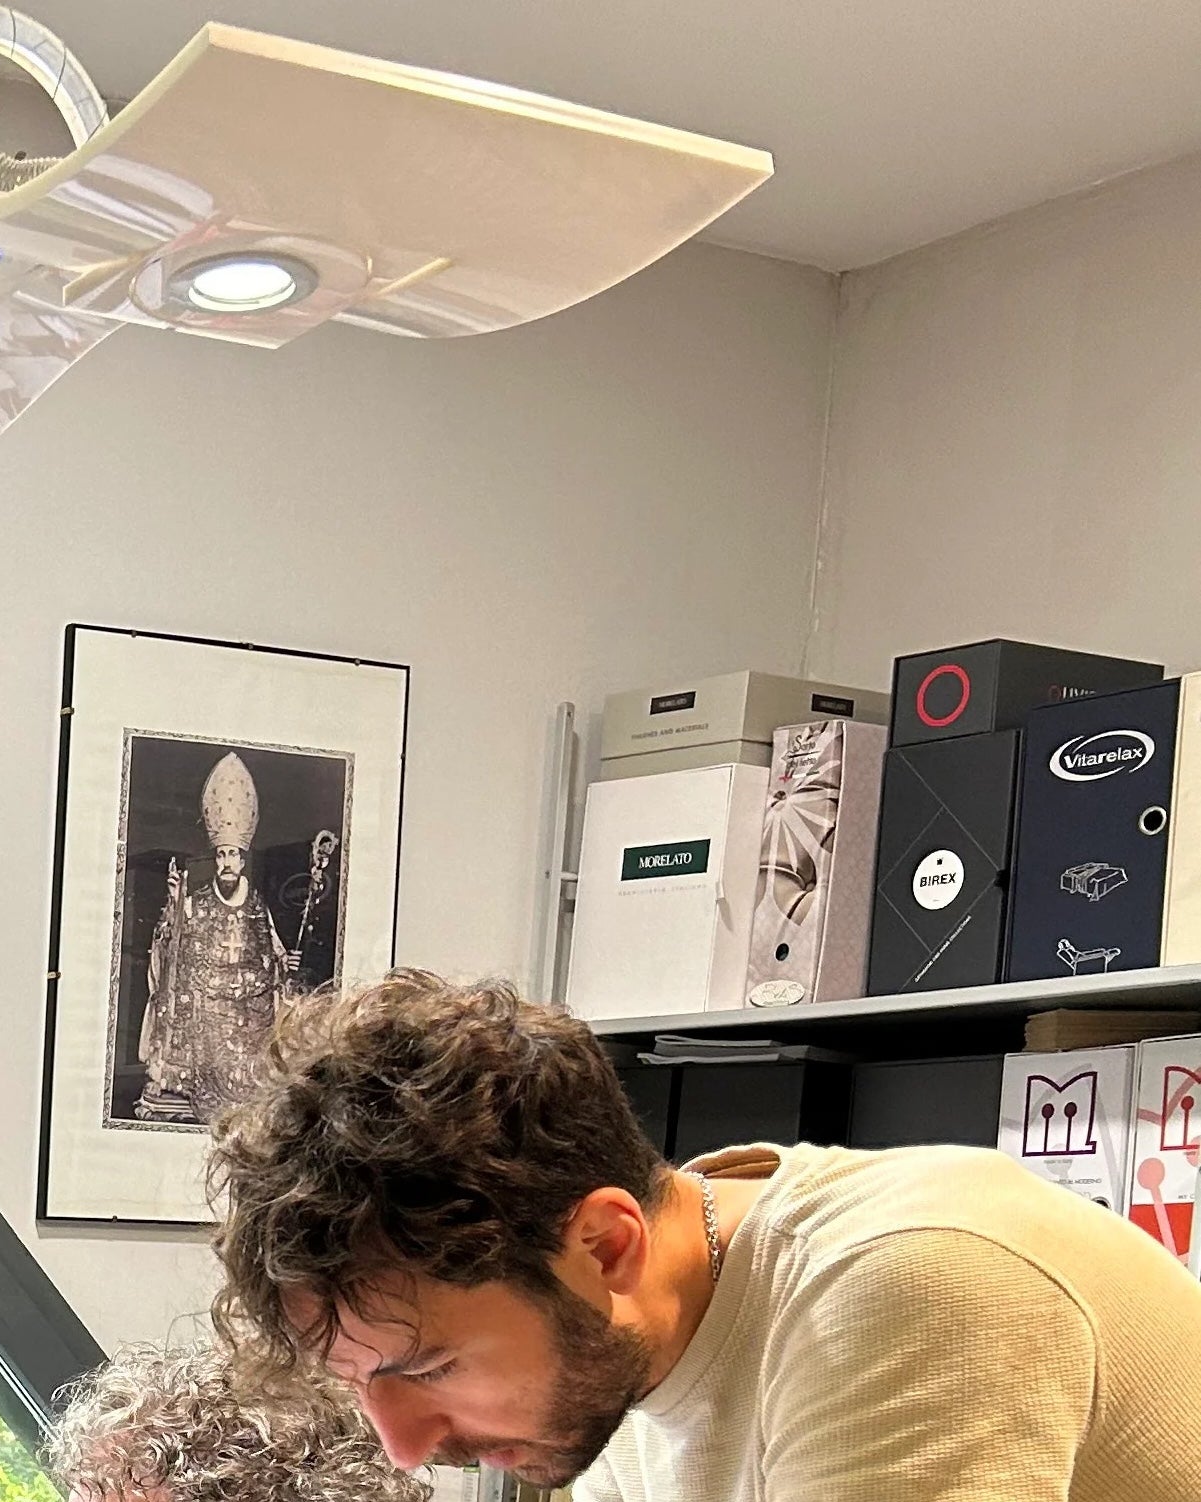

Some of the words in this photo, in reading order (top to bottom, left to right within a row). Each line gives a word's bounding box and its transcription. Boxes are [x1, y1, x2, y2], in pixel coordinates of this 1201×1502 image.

[1063, 747, 1143, 769] Vitarelax
[638, 852, 693, 869] MORELATO
[919, 872, 957, 888] BIREX
